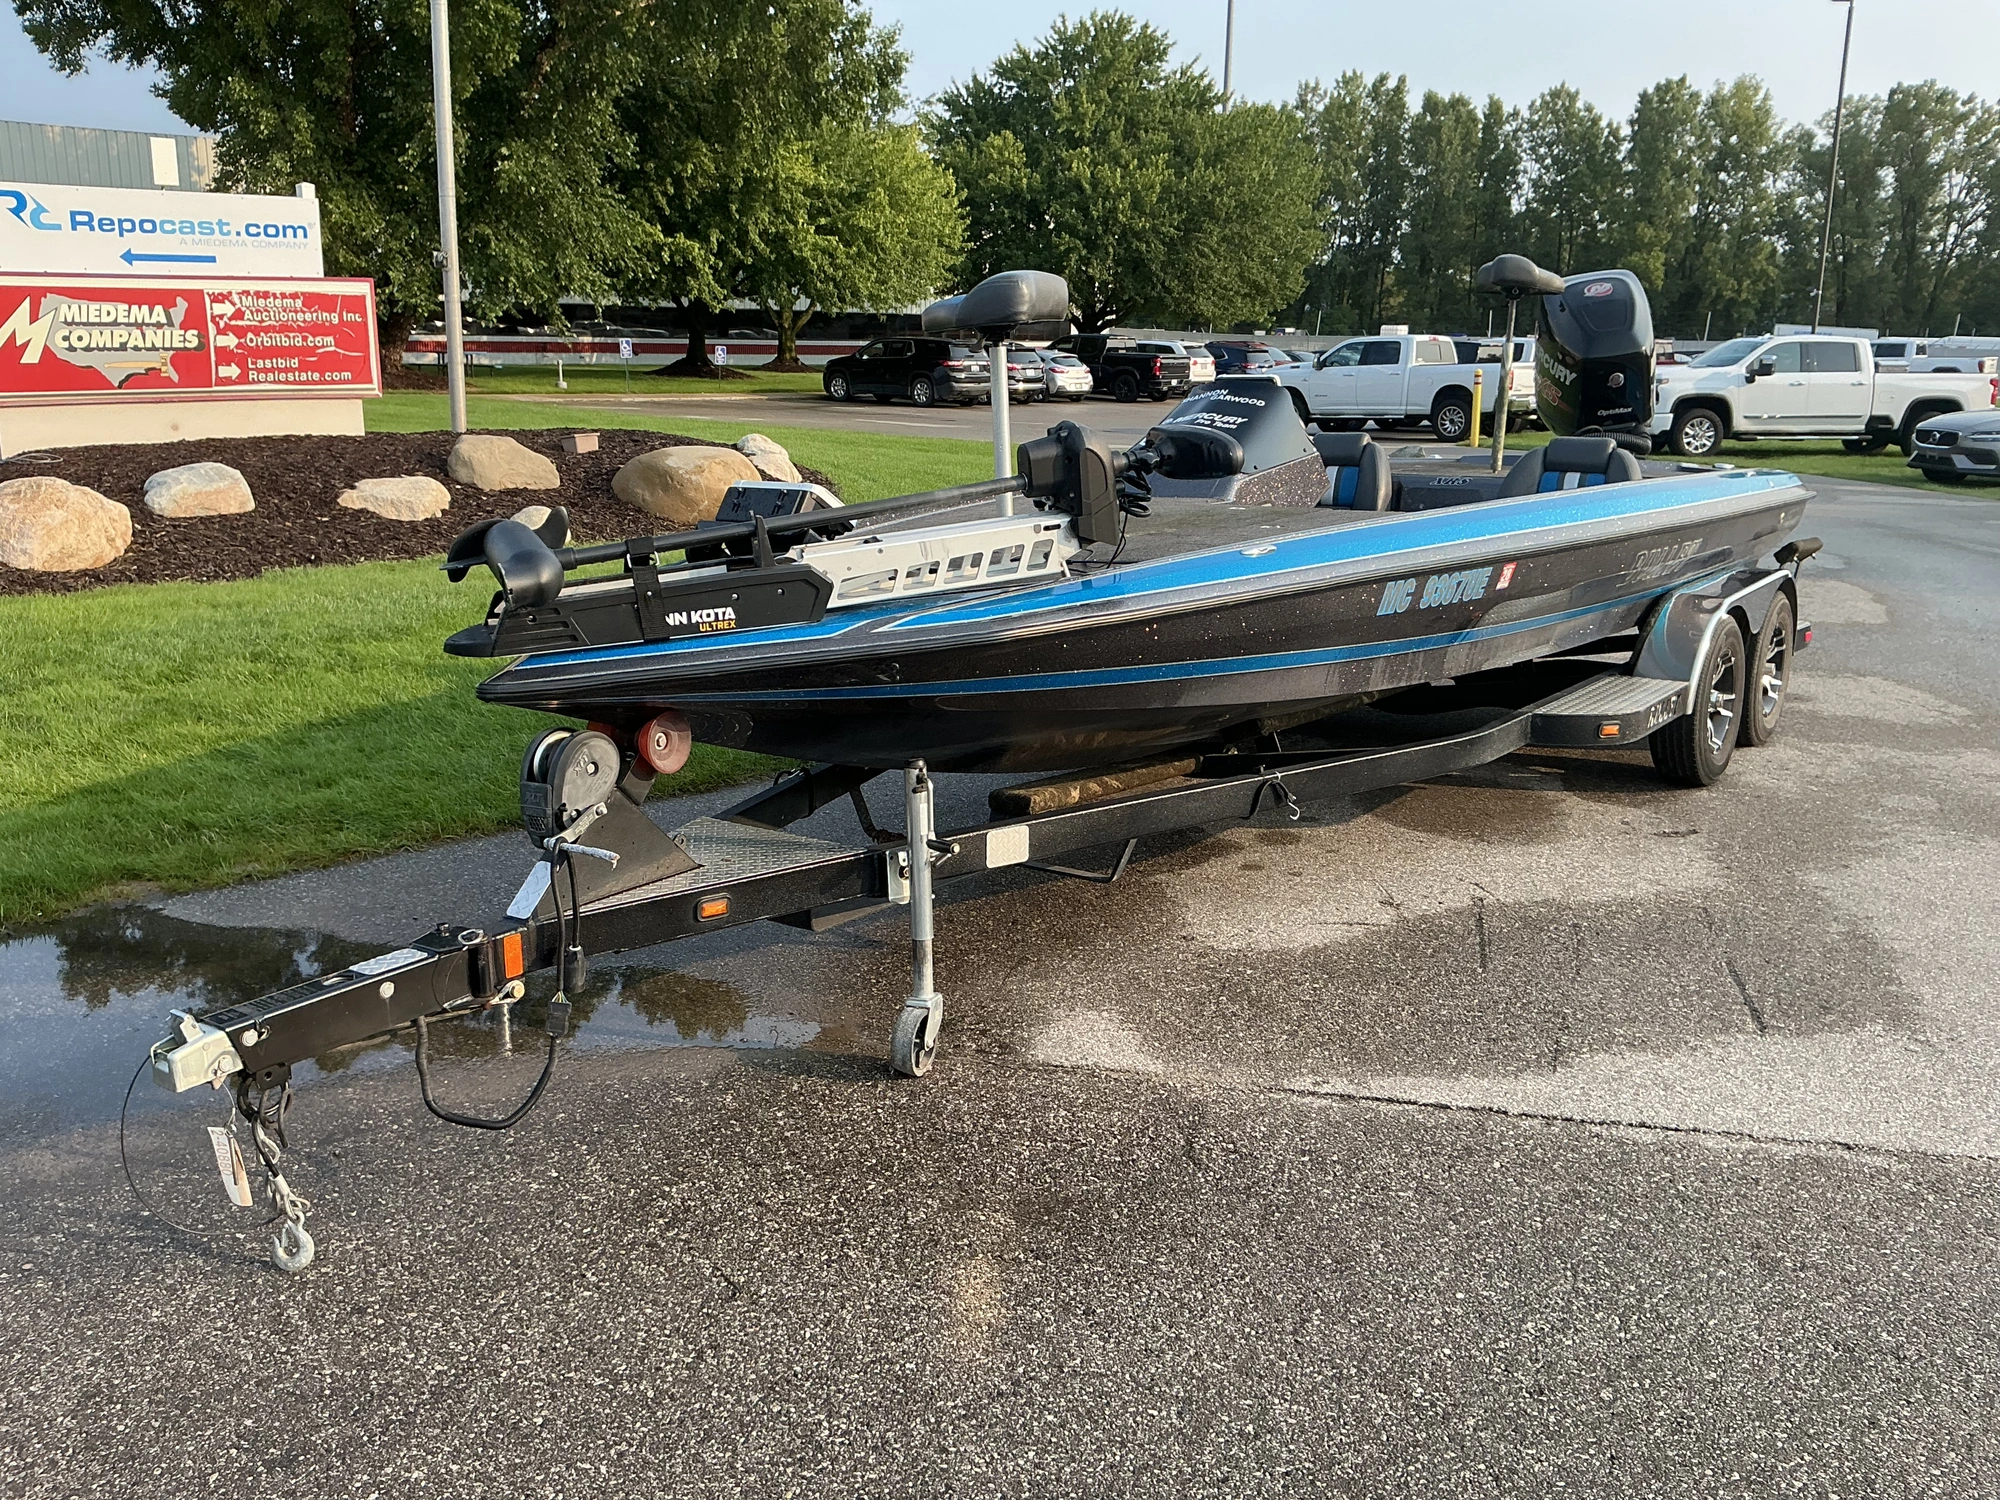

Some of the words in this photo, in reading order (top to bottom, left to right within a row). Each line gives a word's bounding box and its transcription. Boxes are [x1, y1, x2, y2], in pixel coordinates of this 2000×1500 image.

[69, 209, 309, 240] Repocast.com
[179, 238, 188, 246] A
[191, 238, 248, 248] MIEDEMA
[251, 240, 309, 250] COMPANY
[242, 295, 303, 308] Miedema
[58, 303, 170, 325] MIEDEMA
[243, 309, 339, 324] Auctioneering
[54, 328, 201, 350] COMPANIES
[246, 333, 335, 347] Orbitbid.com
[247, 357, 299, 369] Lastbid
[248, 370, 352, 383] Realestate.com
[1210, 394, 1266, 407] GARWOOD
[1376, 578, 1417, 616] MC
[690, 606, 736, 624] KOTA
[699, 620, 736, 632] ULTREX
